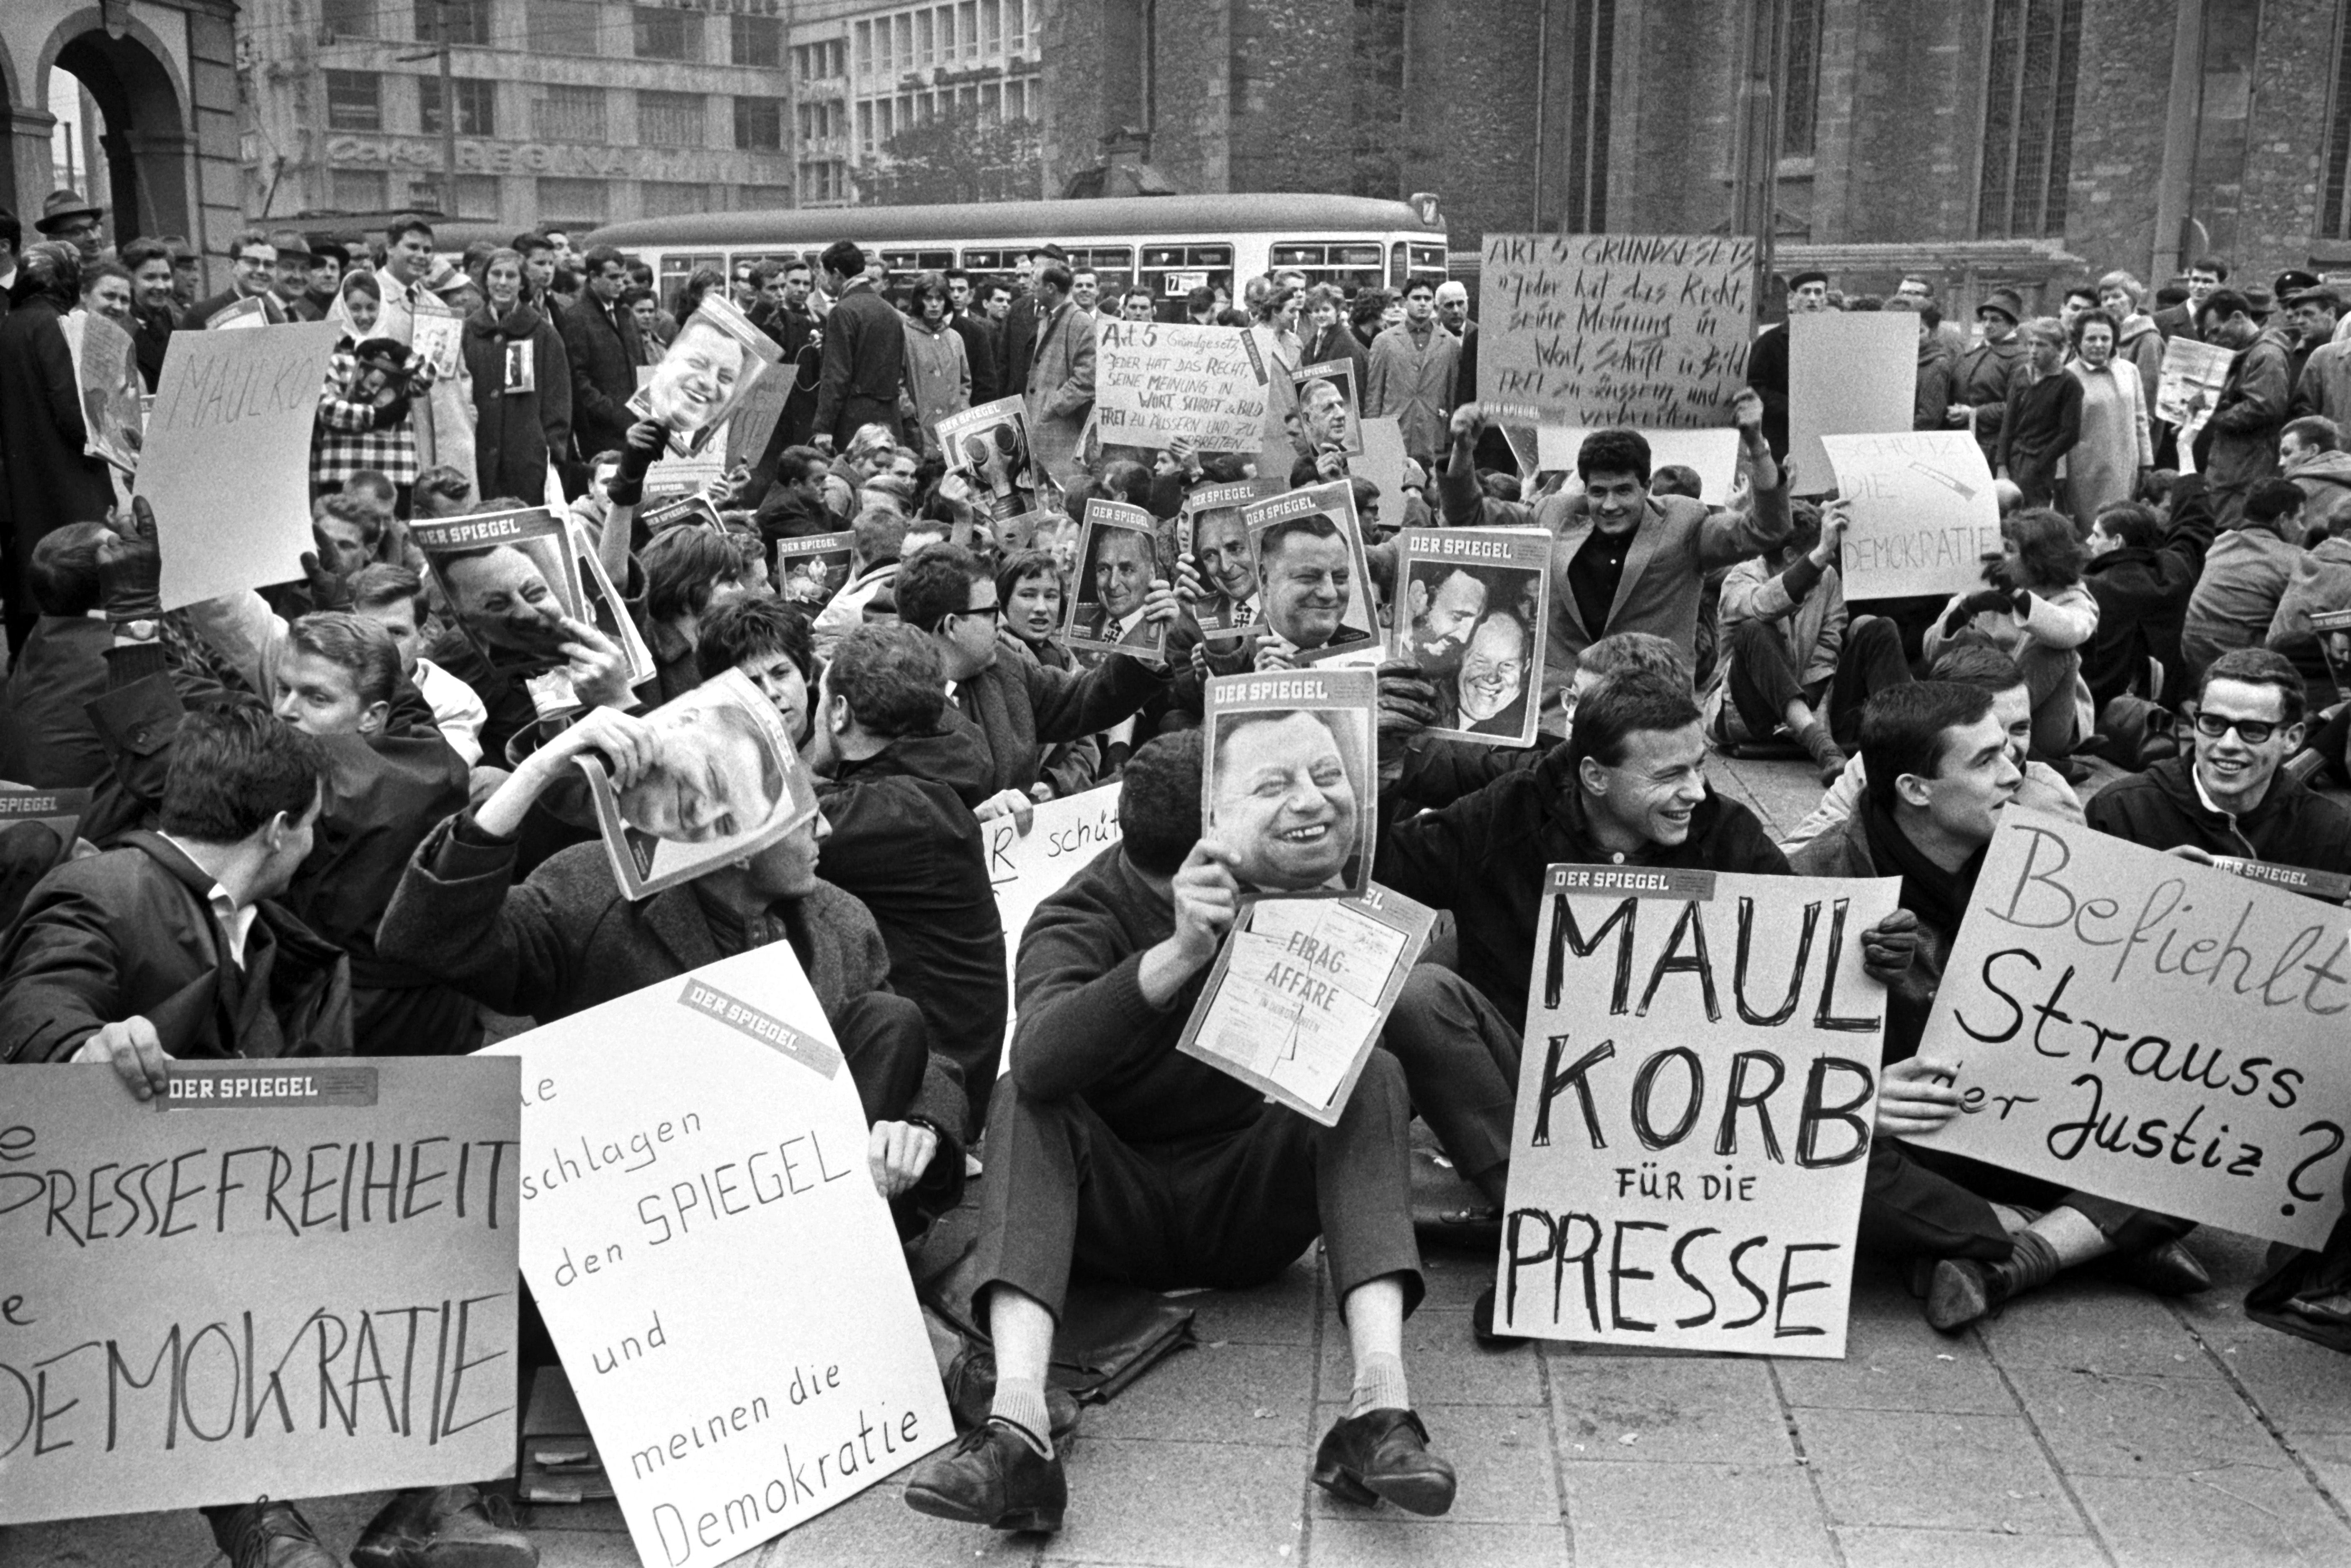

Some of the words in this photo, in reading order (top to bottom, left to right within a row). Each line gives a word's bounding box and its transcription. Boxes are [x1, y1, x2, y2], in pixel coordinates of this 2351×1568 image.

[1142, 324, 1158, 347] 5
[1146, 357, 1172, 371] HAT
[1174, 359, 1202, 372] DAS
[1108, 372, 1145, 387] SEINE
[1147, 375, 1210, 395] MEINUNG
[1218, 382, 1233, 395] IN
[939, 418, 959, 433] DER
[959, 404, 1001, 424] SPIEGEL
[1098, 406, 1126, 427] FREI
[1129, 412, 1146, 427] ZU
[1206, 420, 1230, 434] UND
[1235, 422, 1257, 437] ZU
[1237, 399, 1264, 417] BILD
[1207, 486, 1254, 504] SPIEGEL
[1092, 506, 1113, 519] DER
[1246, 509, 1265, 526] DER
[1267, 496, 1316, 519] SPIEGEL
[449, 518, 521, 543] SPIEGEL
[782, 542, 799, 553] DER
[801, 538, 837, 550] SPIEGEL
[1410, 536, 1440, 553] DER
[1444, 538, 1512, 559] SPIEGEL
[1215, 683, 1247, 704] DER
[1249, 680, 1329, 701] SPIEGEL
[0, 796, 57, 813] SPIEGEL
[1555, 869, 1591, 887] DER
[1594, 871, 1670, 892] SPIEGEL
[2245, 862, 2309, 887] SPIEGEL
[1544, 893, 1882, 1034] MAUL
[690, 987, 729, 1015] DER
[727, 1005, 798, 1051] SPIEGEL
[1953, 948, 2305, 1109] Strauss
[169, 1078, 214, 1098] DER
[220, 1076, 318, 1098] SPIEGEL
[1531, 1033, 1877, 1170] KORB
[521, 1110, 702, 1200] schlagen
[1612, 1162, 1684, 1200] FÜR
[554, 1243, 623, 1288] den
[637, 1130, 852, 1246] SPIEGEL
[1505, 1206, 1841, 1339] PRESSE
[591, 1309, 668, 1375] und
[629, 1395, 770, 1481] meinen
[789, 1362, 842, 1407] die
[651, 1401, 919, 1568] Demokratie
